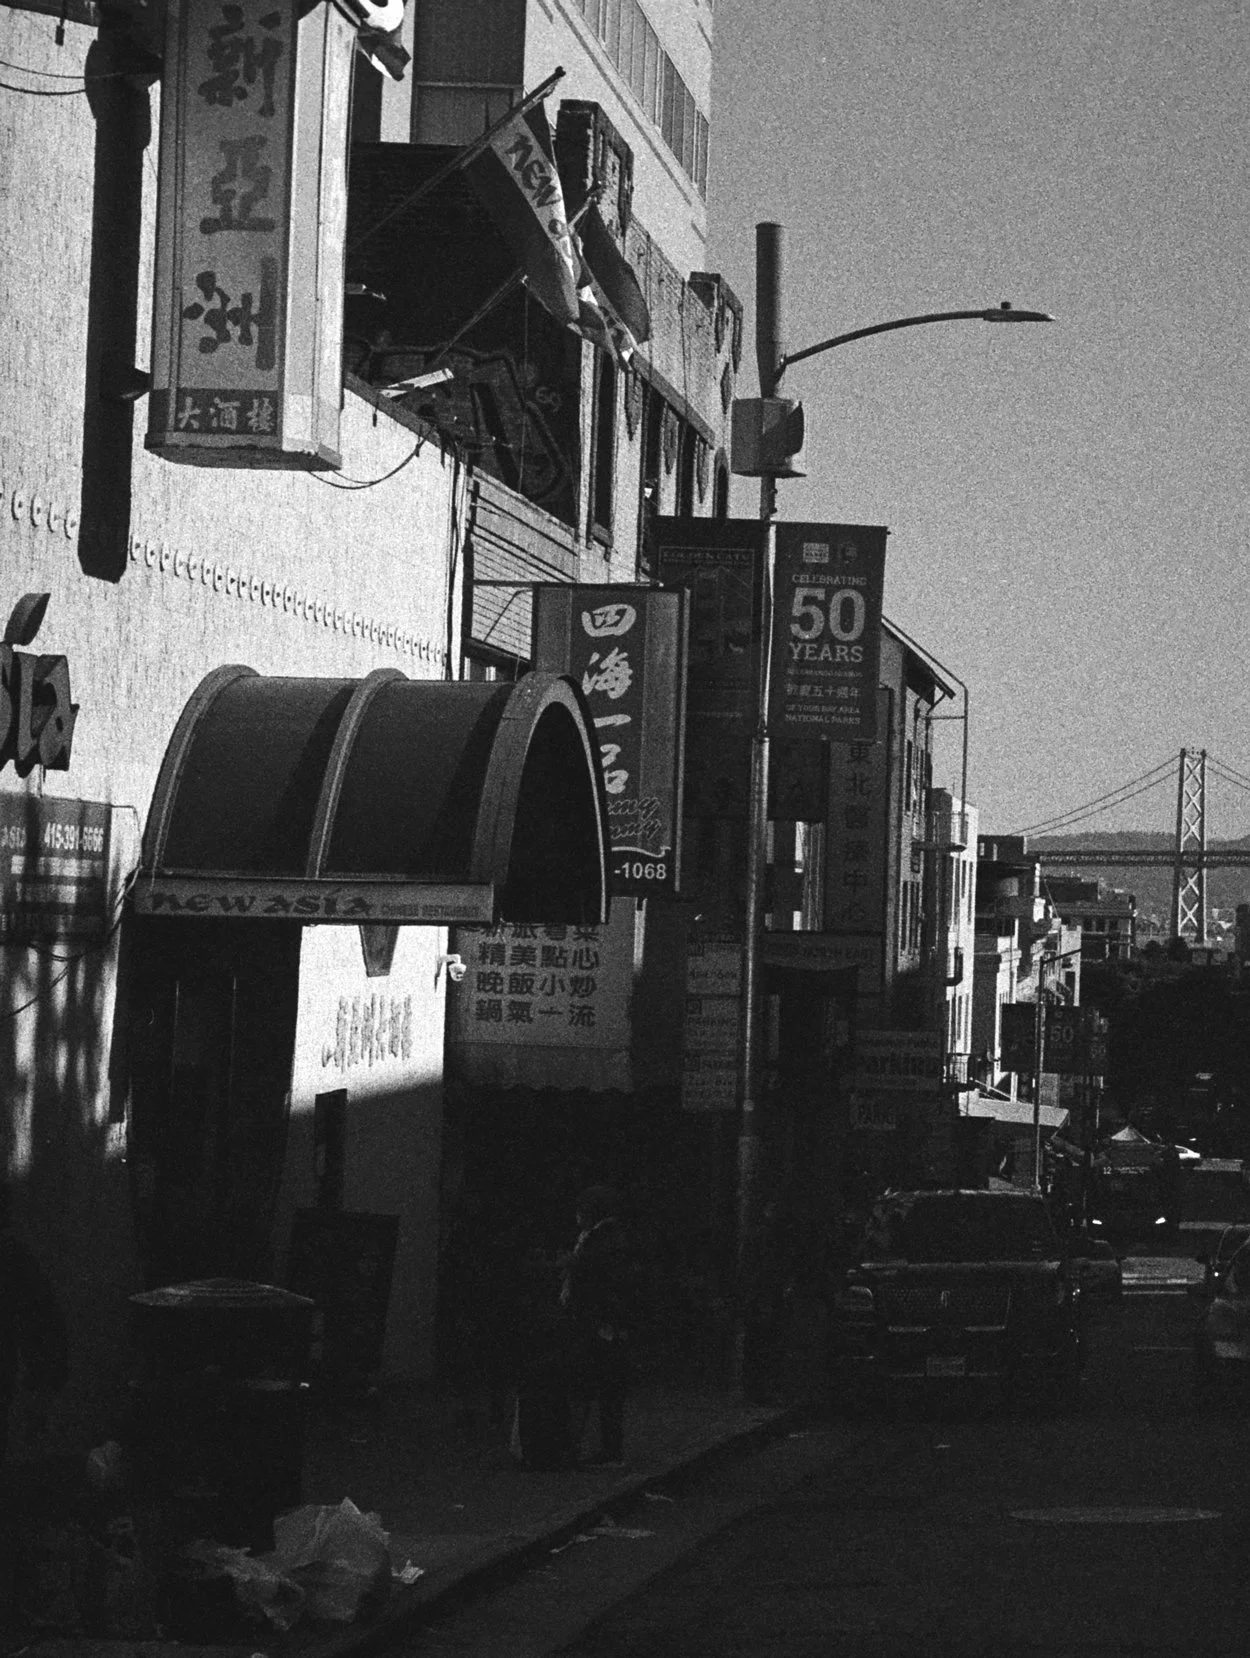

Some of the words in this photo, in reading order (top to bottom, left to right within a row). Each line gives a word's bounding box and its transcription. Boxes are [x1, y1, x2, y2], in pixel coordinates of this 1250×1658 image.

[178, 397, 275, 432] 大酒樓
[792, 574, 867, 586] CELEBRATING
[790, 587, 866, 641] 50
[789, 642, 863, 663] YEARS
[784, 714, 829, 723] NATIONAL
[831, 715, 861, 725] PARKS
[479, 942, 600, 970] 精美點心
[476, 971, 597, 998] 晚飯小炒
